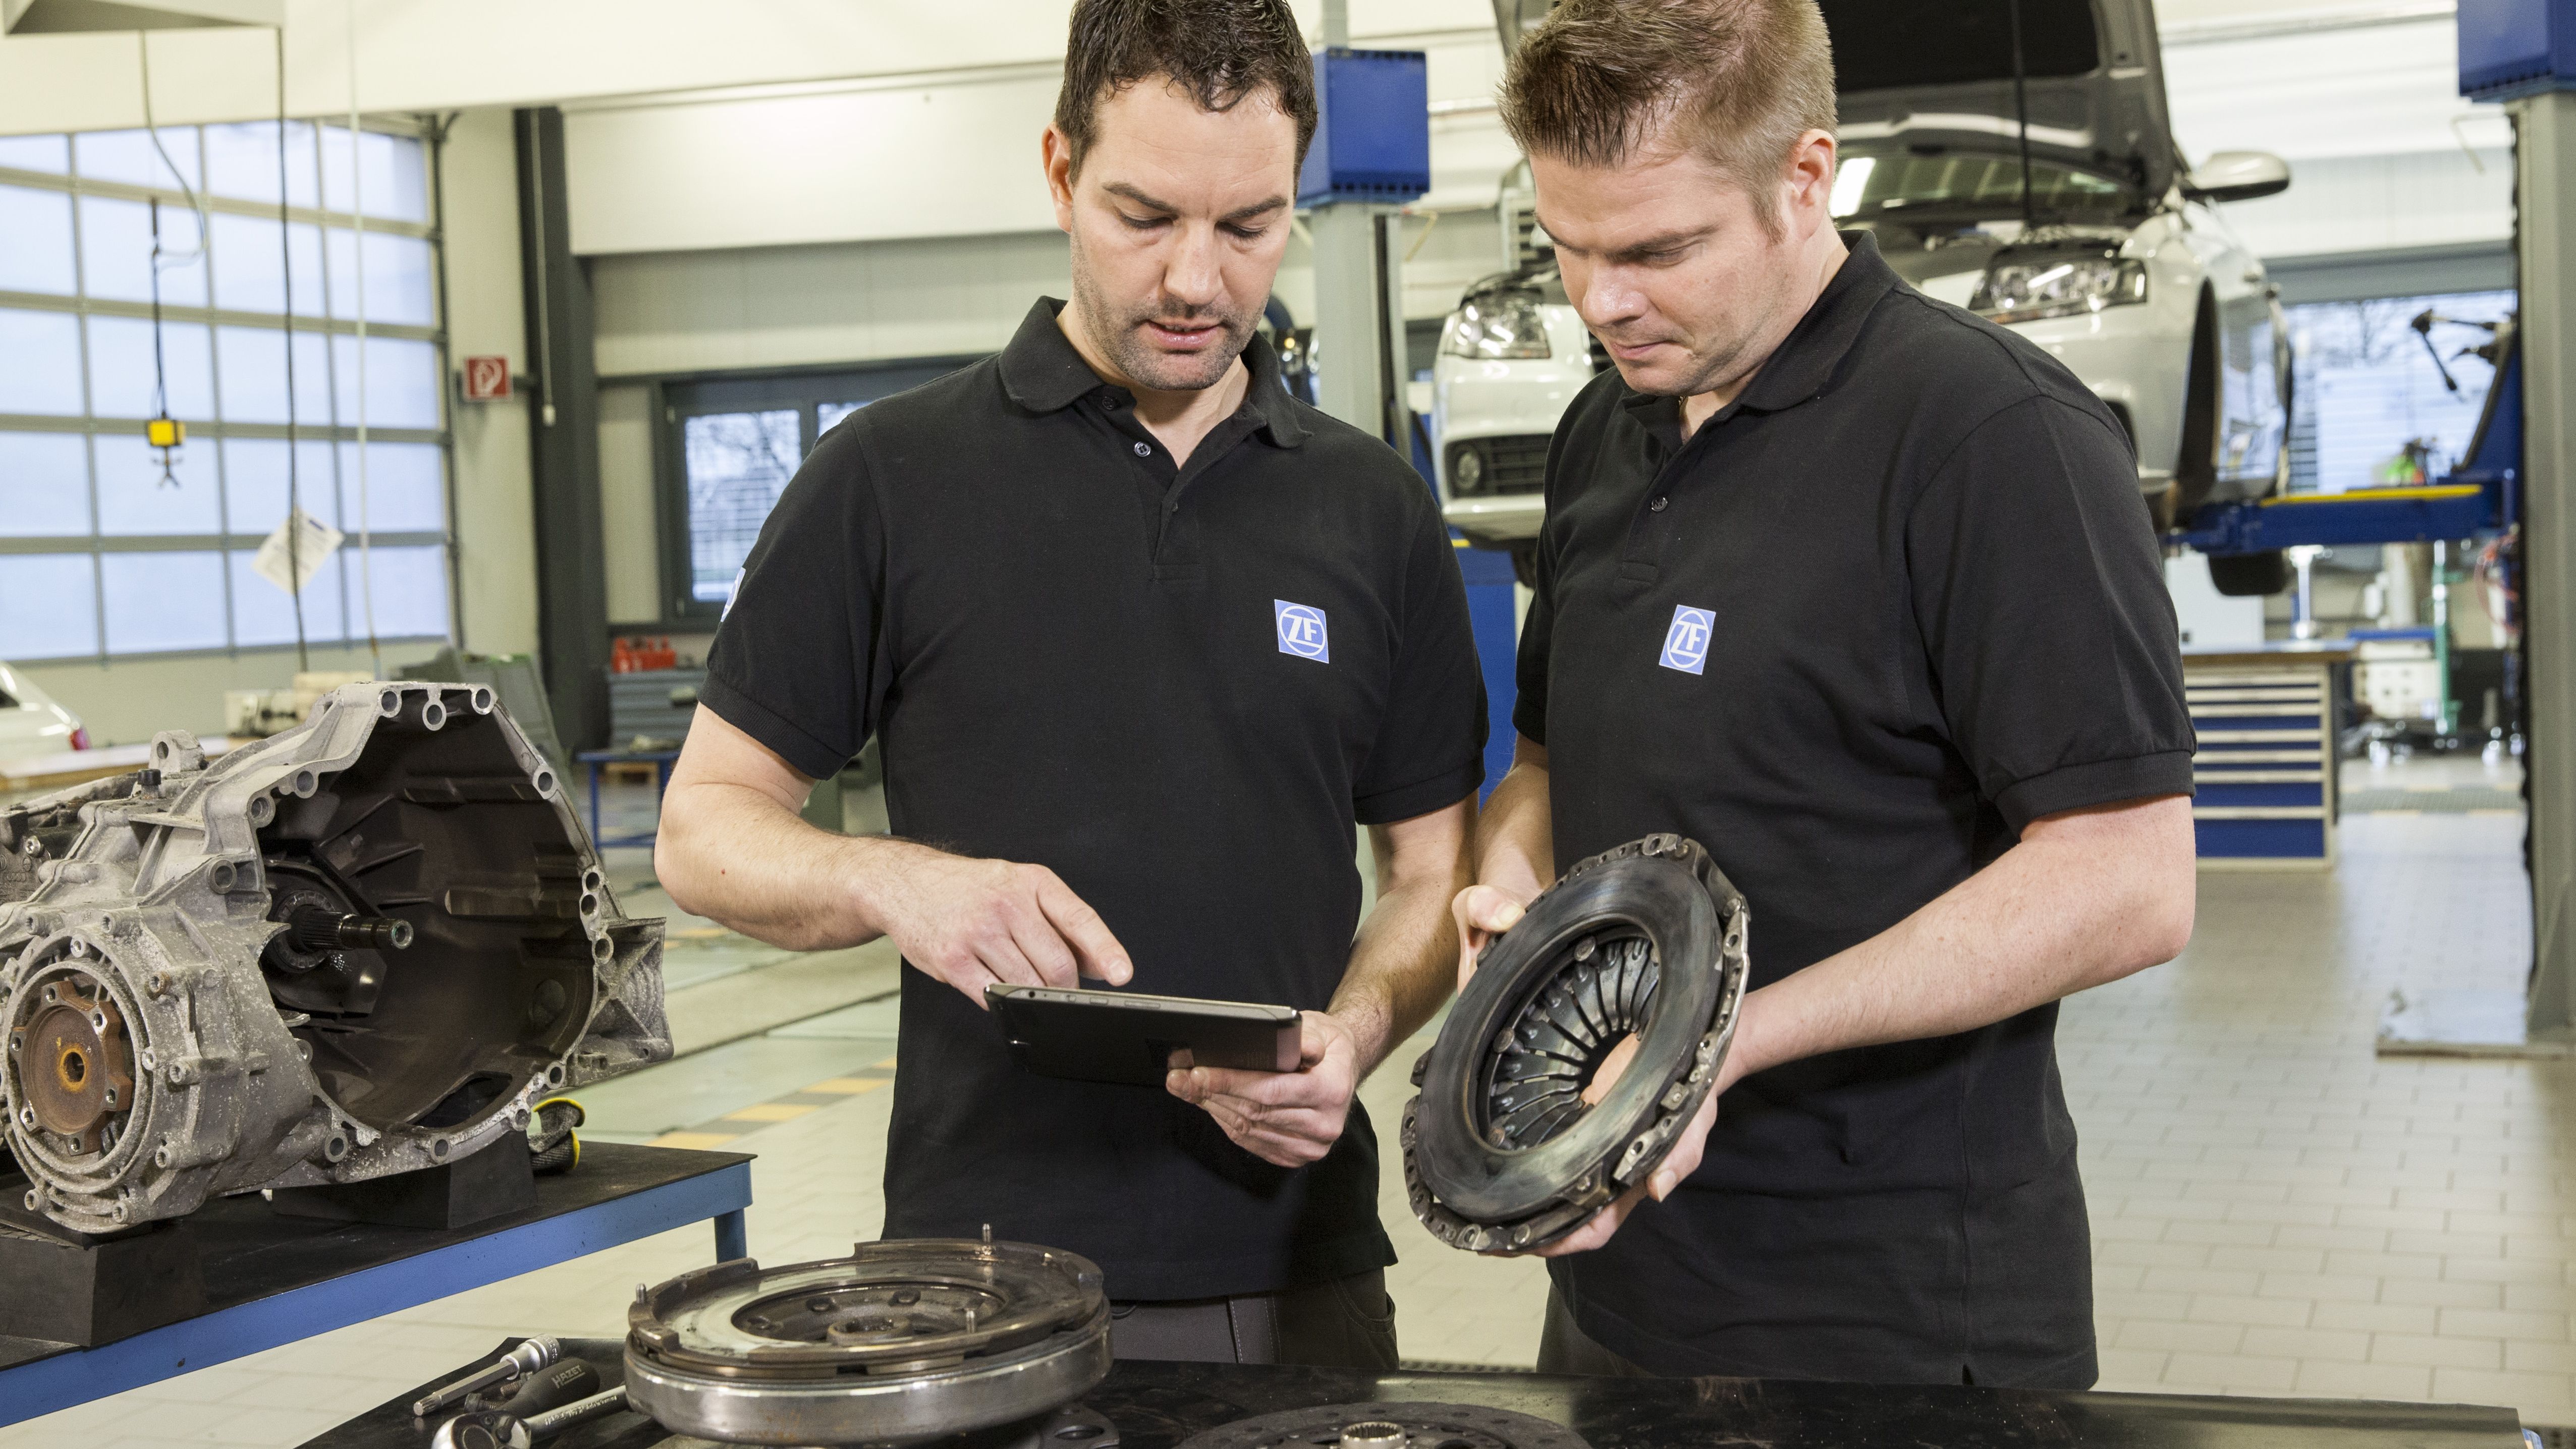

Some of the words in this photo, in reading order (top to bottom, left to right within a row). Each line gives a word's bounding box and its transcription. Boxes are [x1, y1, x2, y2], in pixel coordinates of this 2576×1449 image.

[1280, 612, 1323, 649] ZF
[1670, 619, 1709, 659] ZF
[551, 1364, 584, 1389] HAZET
